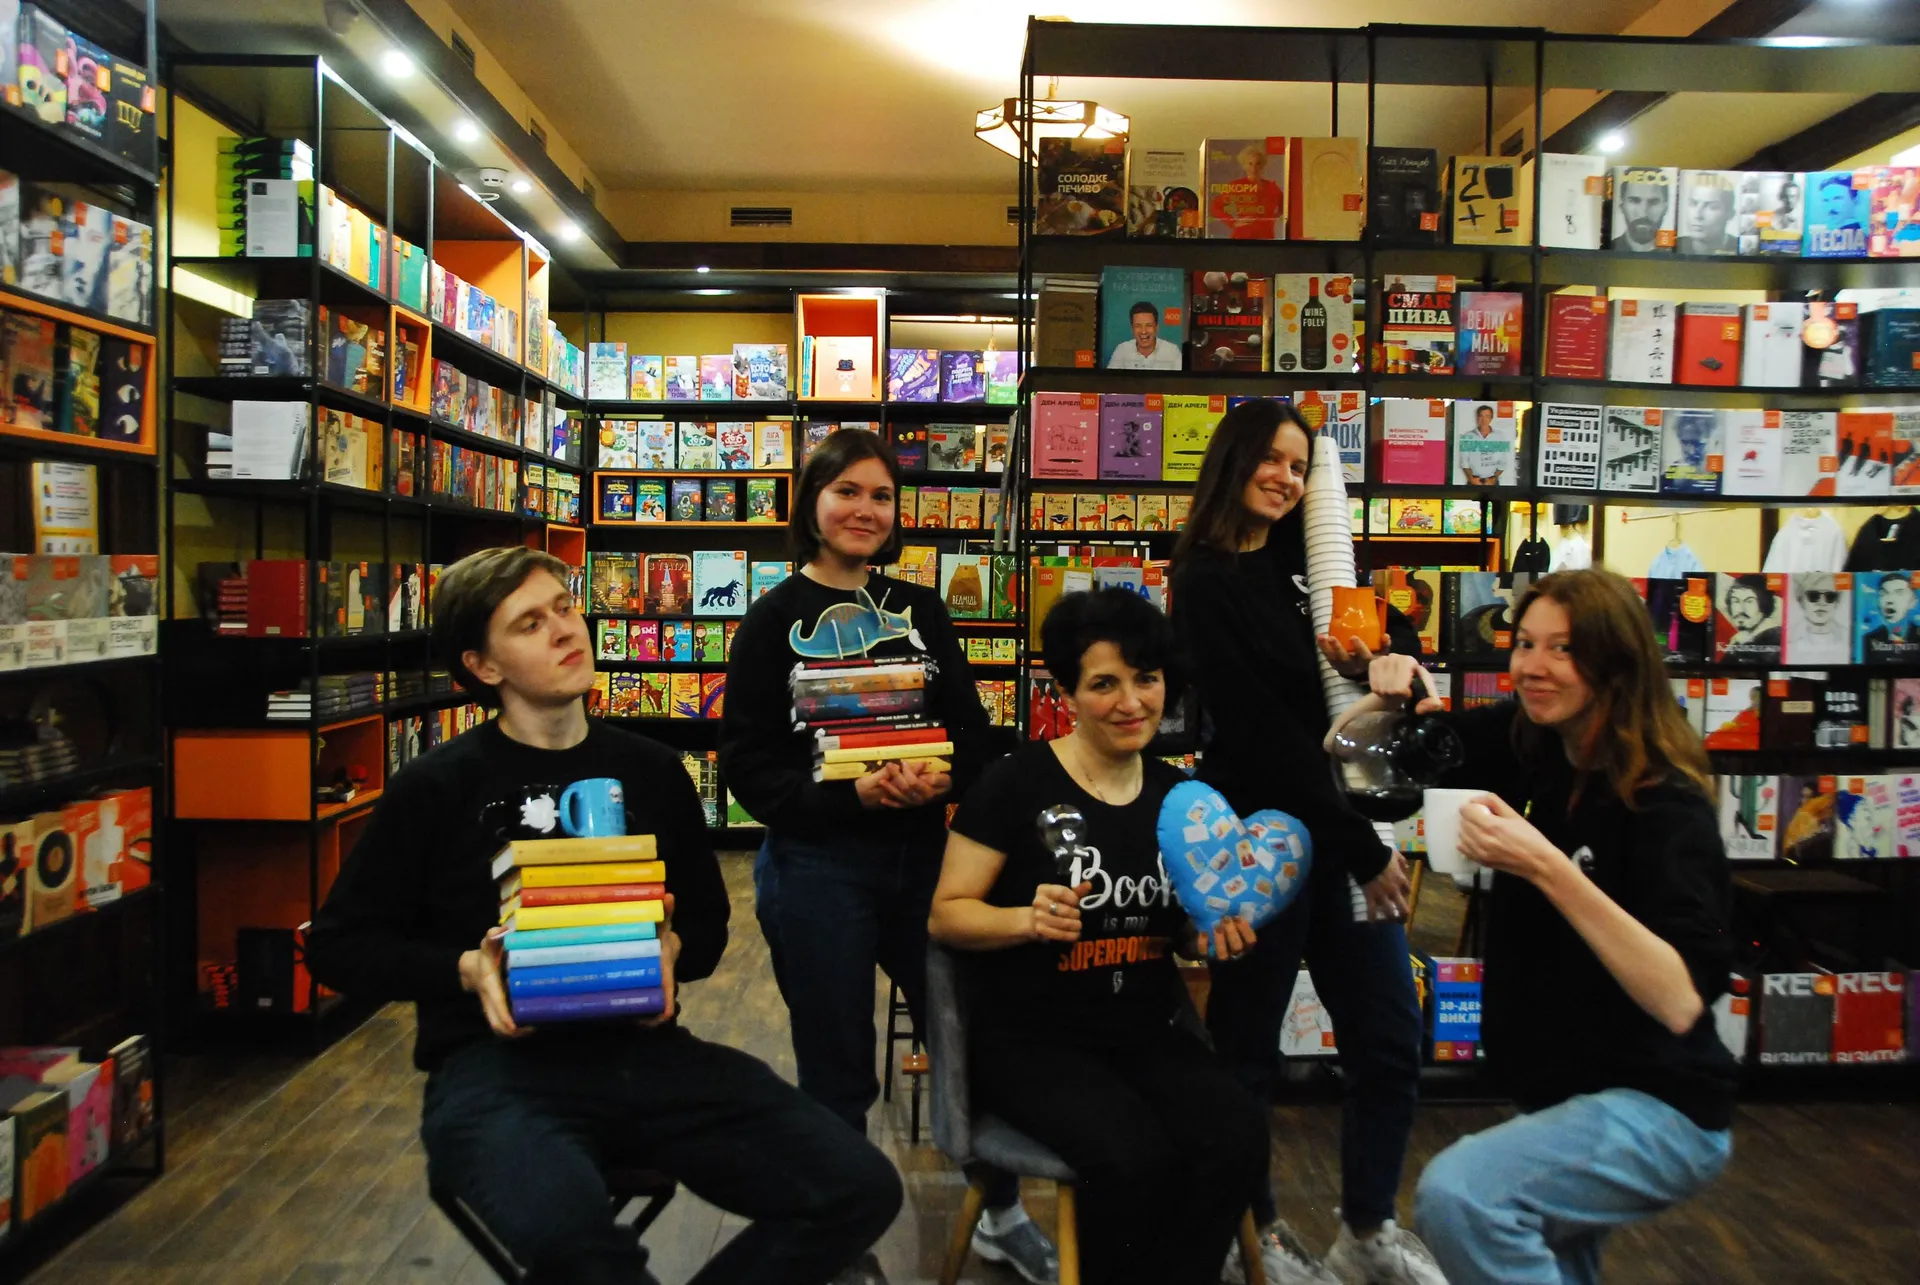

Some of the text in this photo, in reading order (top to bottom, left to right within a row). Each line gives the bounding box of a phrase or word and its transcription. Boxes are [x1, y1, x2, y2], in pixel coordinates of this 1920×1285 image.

[1058, 174, 1108, 183] СОЛОДКЕ
[1459, 167, 1484, 202] 2
[1058, 184, 1101, 193] ПЕЧИВО
[1211, 183, 1258, 193] ПІДКОРИ
[1808, 224, 1866, 252] ТЕСЛА
[1388, 293, 1452, 309] СМАК
[1304, 307, 1324, 317] WINE
[1388, 309, 1452, 325] ПИВА
[1467, 310, 1514, 330] ВЕЛИКА
[1302, 318, 1325, 327] FOLLY
[1471, 333, 1509, 353] МАГІЯ
[1549, 406, 1599, 416] Український
[1040, 573, 1053, 581] 180
[1104, 914, 1149, 930] is my
[1763, 974, 1816, 996] RE
